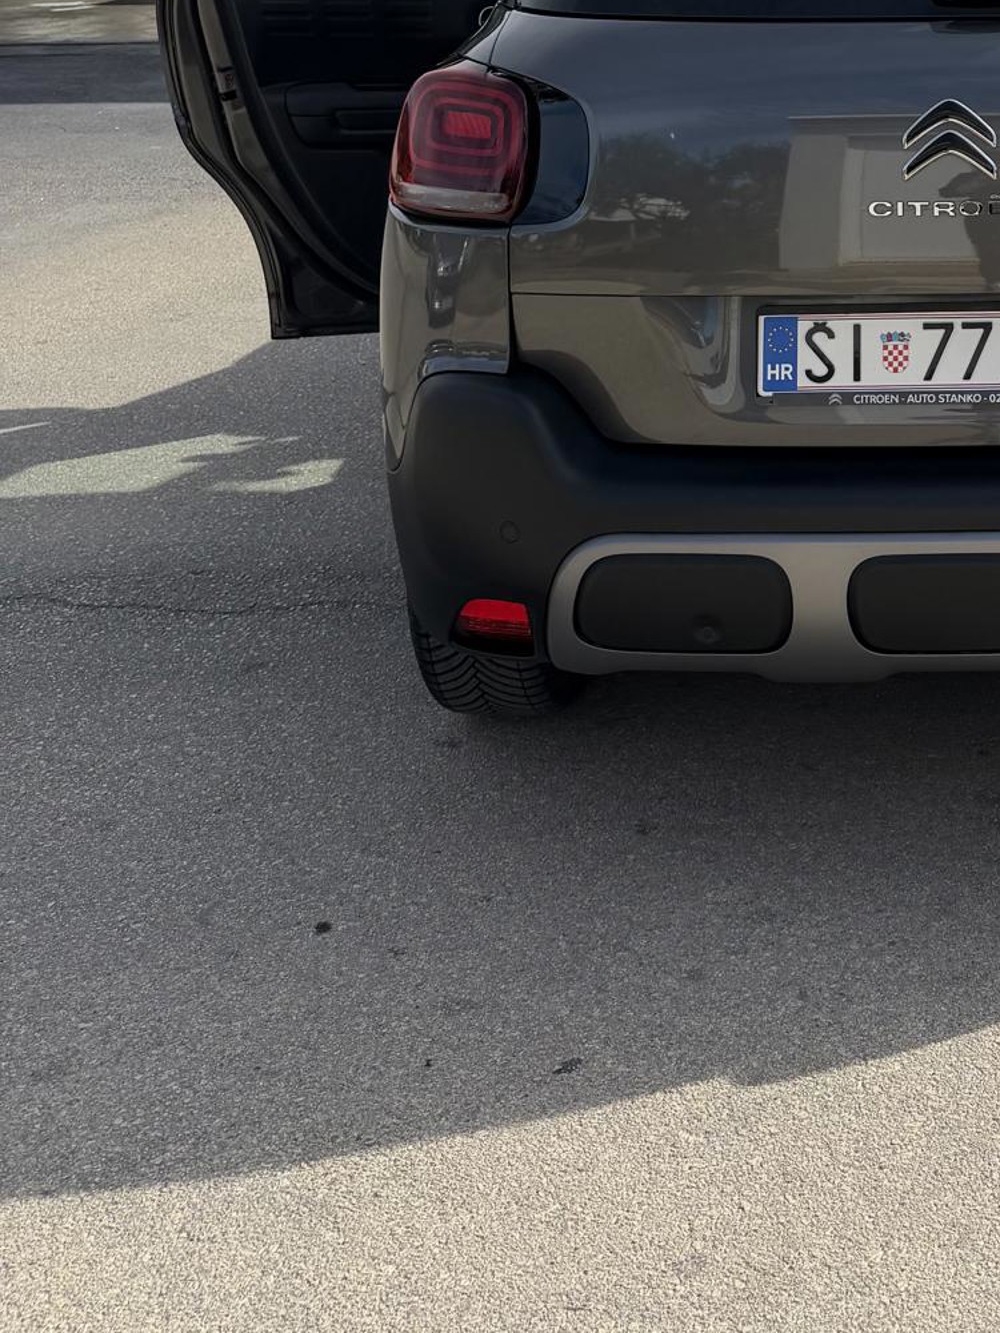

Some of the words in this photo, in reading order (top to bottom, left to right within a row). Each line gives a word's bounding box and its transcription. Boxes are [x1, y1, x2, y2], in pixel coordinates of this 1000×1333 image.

[804, 321, 862, 383] ŠI
[767, 363, 793, 381] HR
[907, 393, 936, 404] AUTO
[938, 393, 981, 403] STANKO
